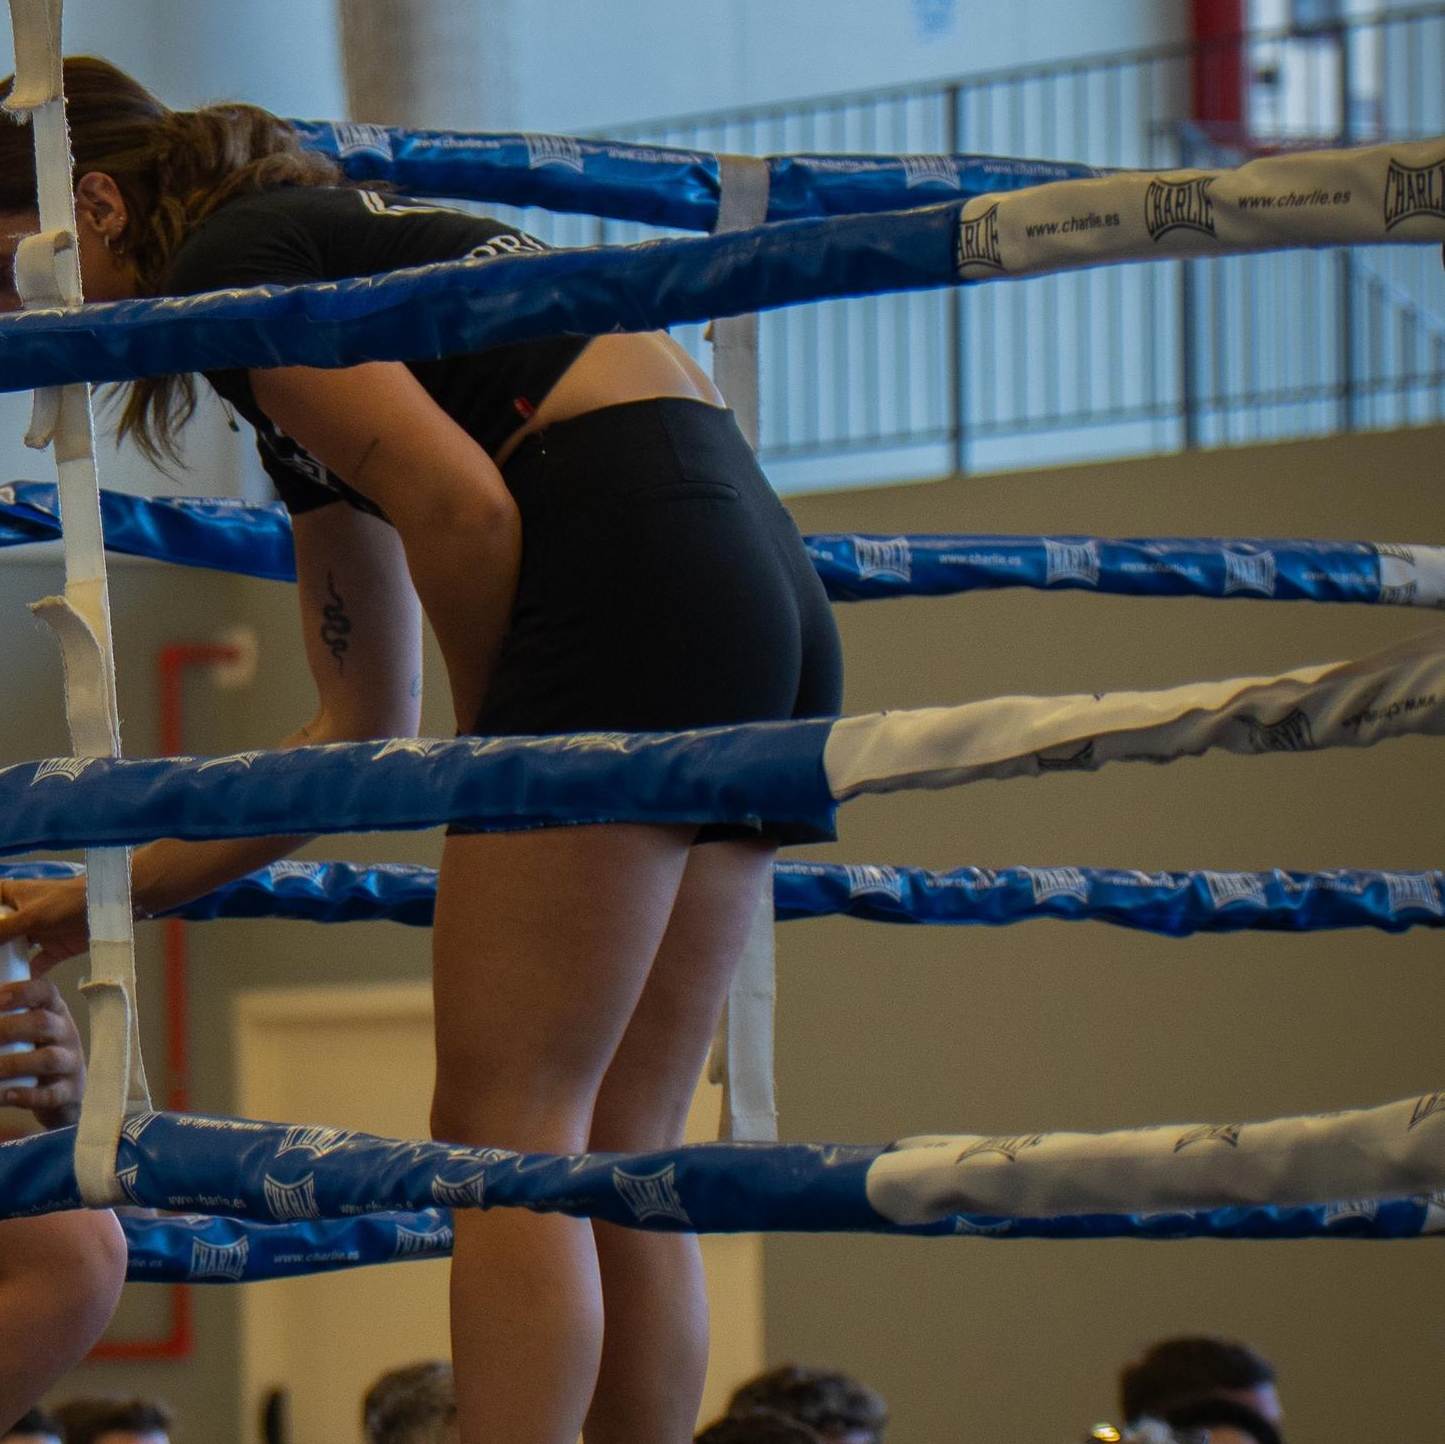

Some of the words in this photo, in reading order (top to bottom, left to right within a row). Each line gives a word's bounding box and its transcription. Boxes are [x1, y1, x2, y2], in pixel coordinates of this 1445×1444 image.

[956, 203, 1005, 272] ARLIE
[1025, 211, 1121, 238] www.charlie.es
[1145, 176, 1217, 243] CHARLIE
[1239, 188, 1352, 210] www.charlie.es
[264, 1170, 321, 1222] CHARLIE
[188, 1234, 250, 1282] CHARLIE
[273, 1249, 360, 1265] www.charlie.es
